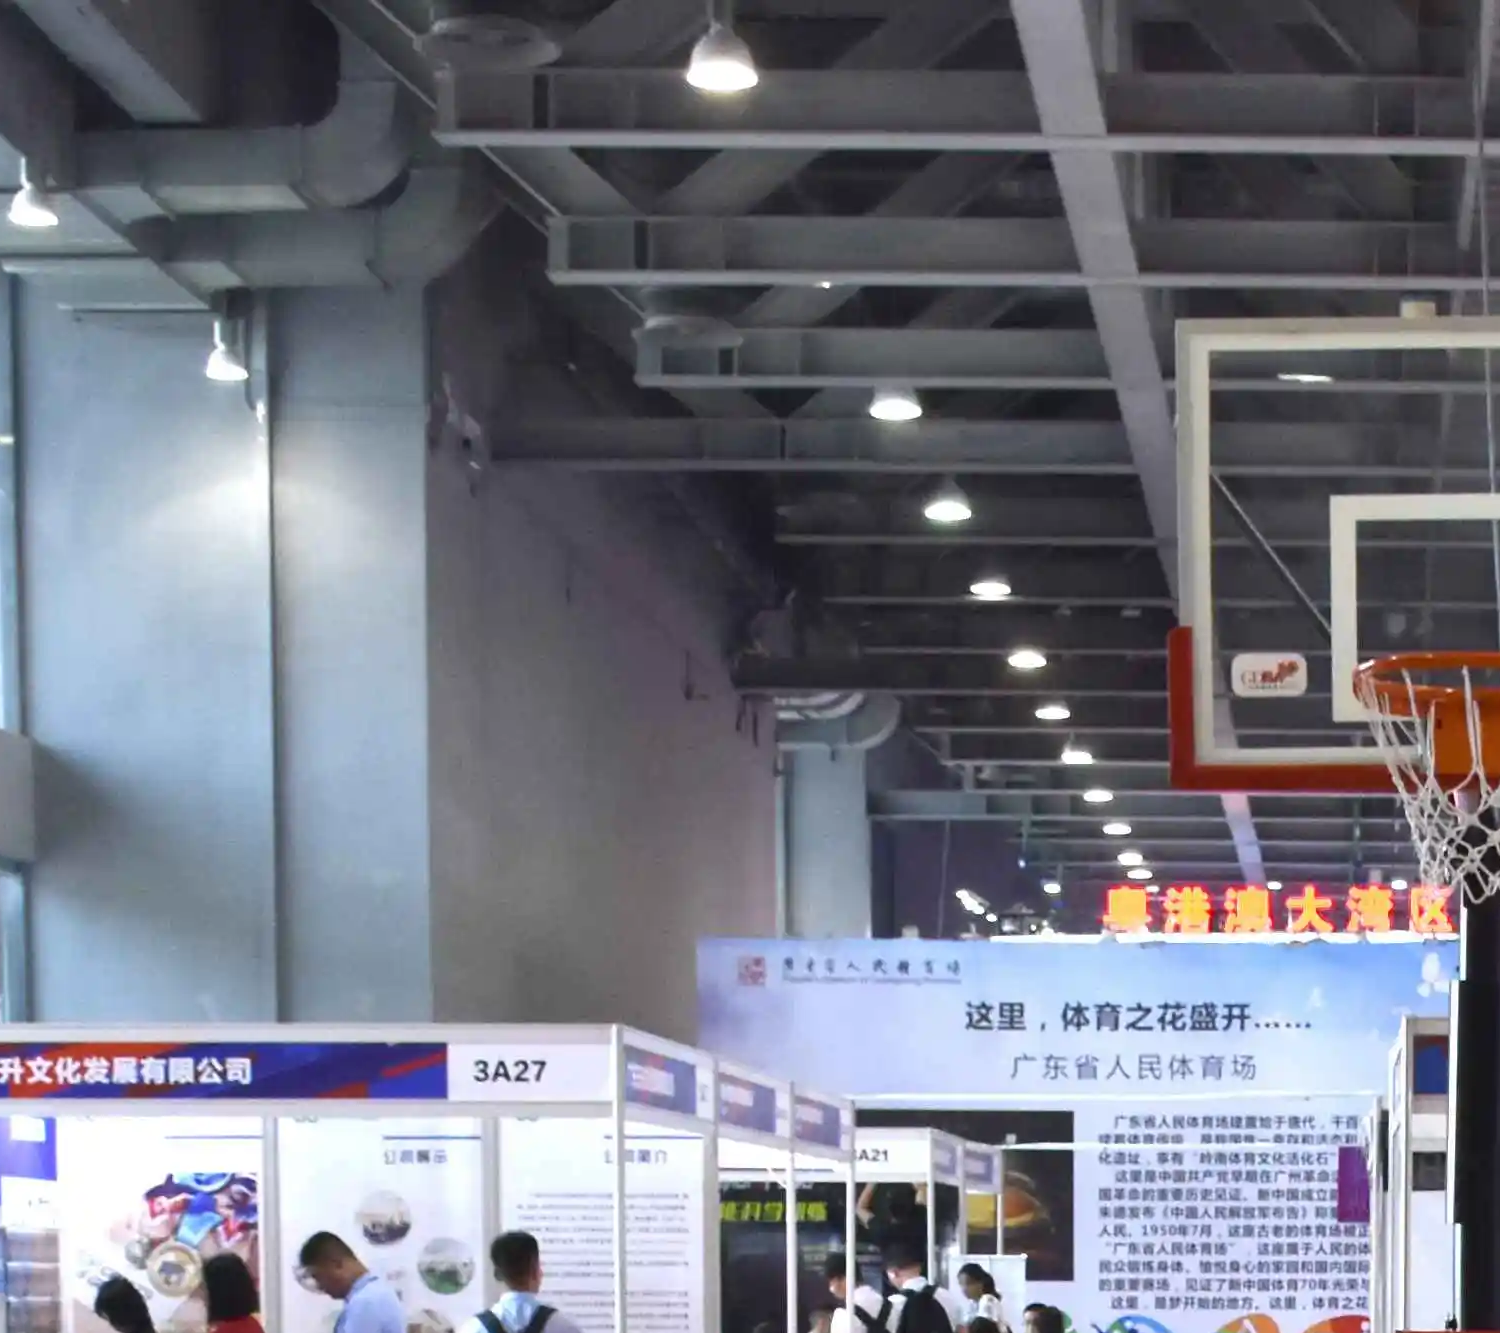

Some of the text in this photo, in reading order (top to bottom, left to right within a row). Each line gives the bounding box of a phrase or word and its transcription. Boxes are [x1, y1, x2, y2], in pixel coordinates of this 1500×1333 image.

[1103, 884, 1456, 933] 粤港澳大湾区
[473, 1060, 547, 1083] 3A27
[1010, 1053, 1257, 1081] 广东省人民体育场
